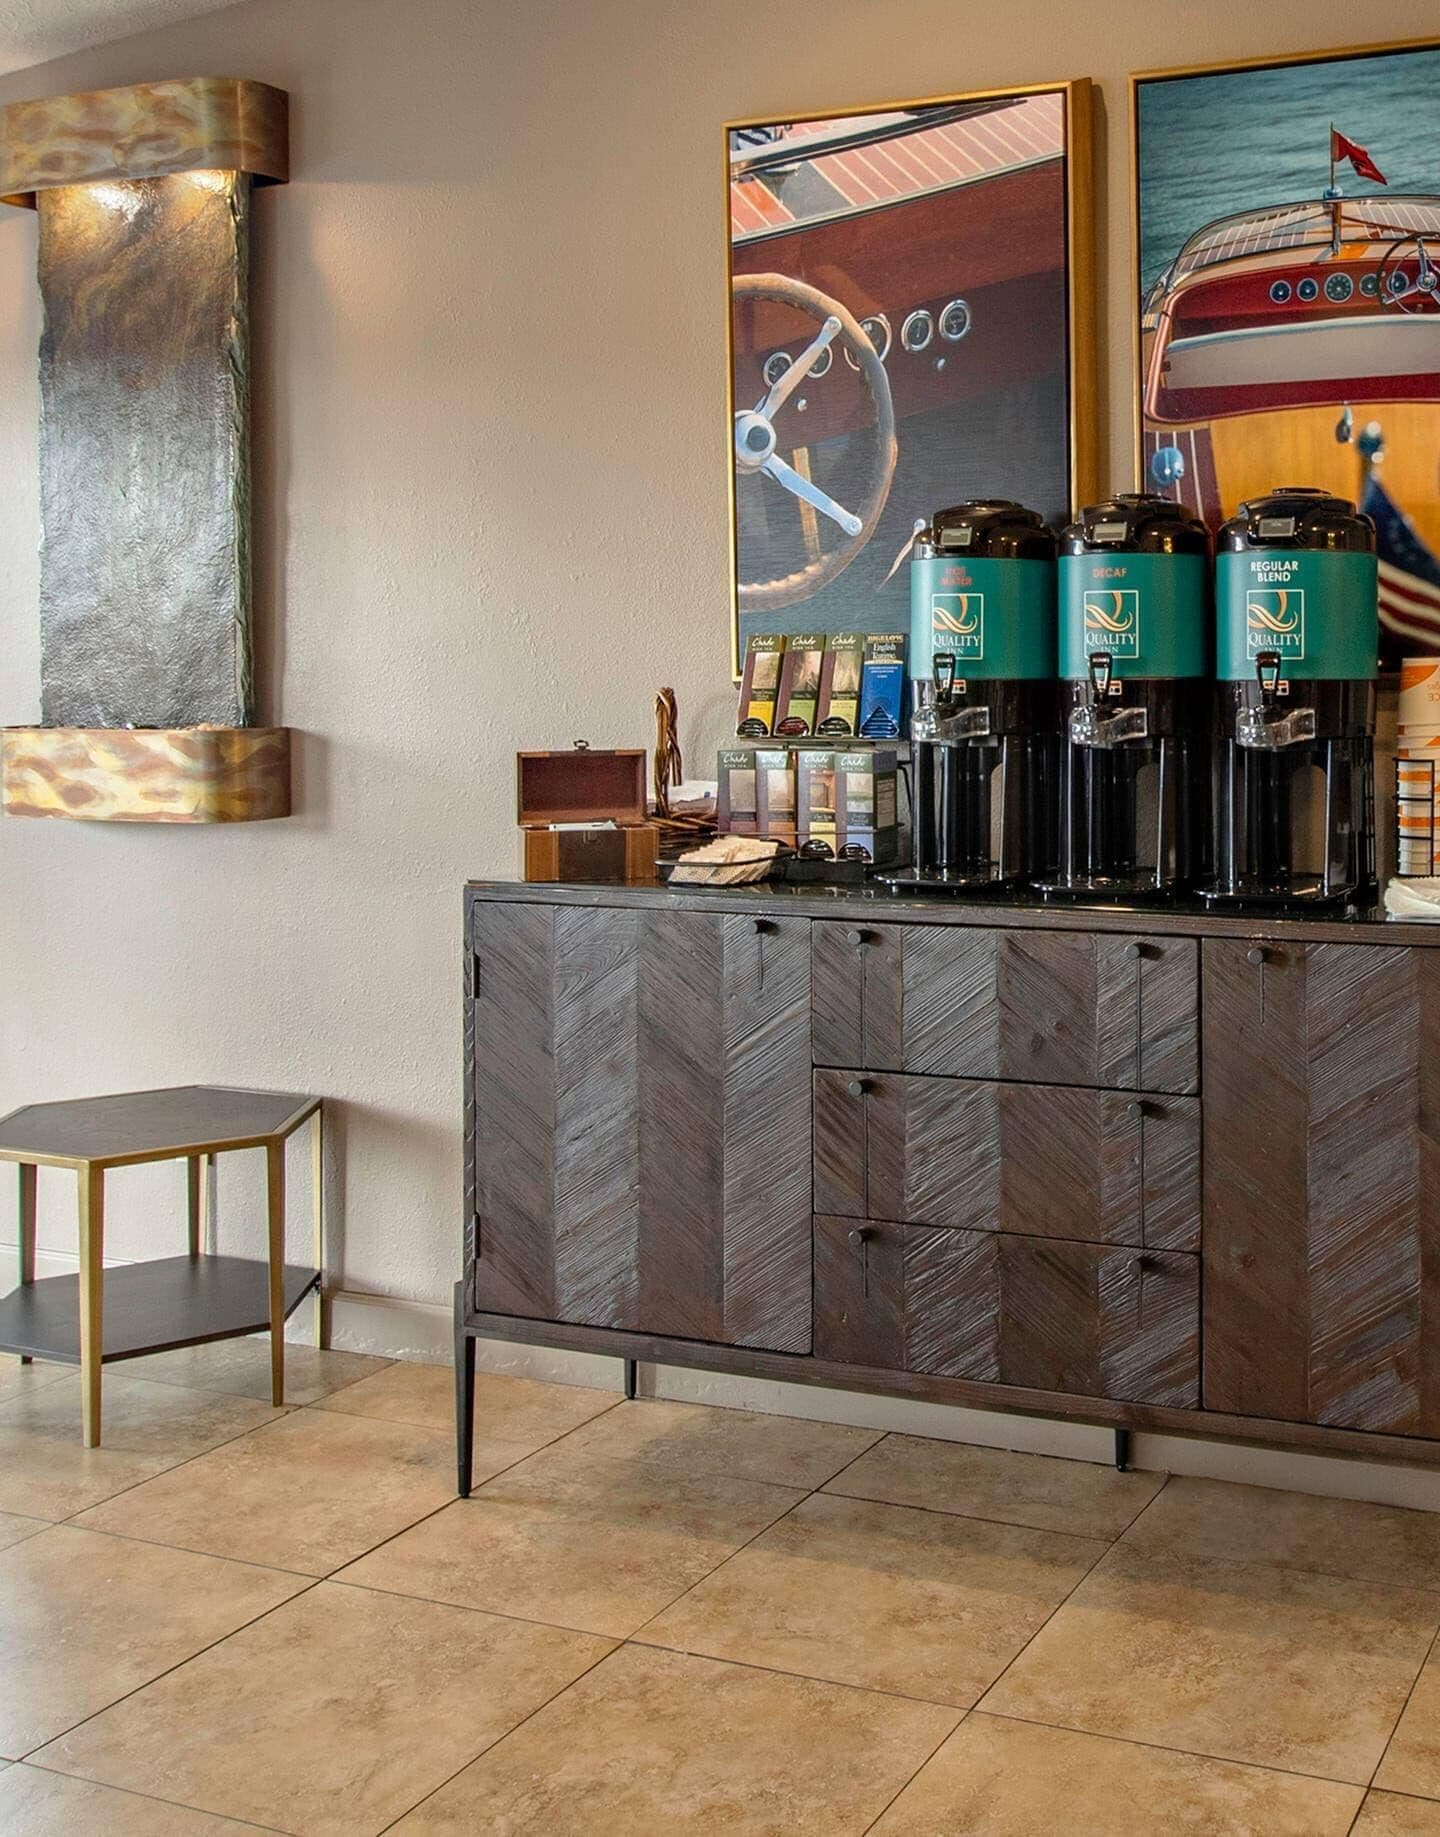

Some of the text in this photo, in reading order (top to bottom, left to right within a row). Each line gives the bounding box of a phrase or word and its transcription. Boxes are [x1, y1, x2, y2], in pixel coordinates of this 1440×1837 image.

[1250, 560, 1299, 572] REGULAR
[1092, 568, 1128, 578] DECAF
[1257, 572, 1291, 582] BLEND
[933, 634, 981, 647] QUALITY
[1086, 631, 1136, 645] QUALITY
[1248, 632, 1301, 647] QUALITY
